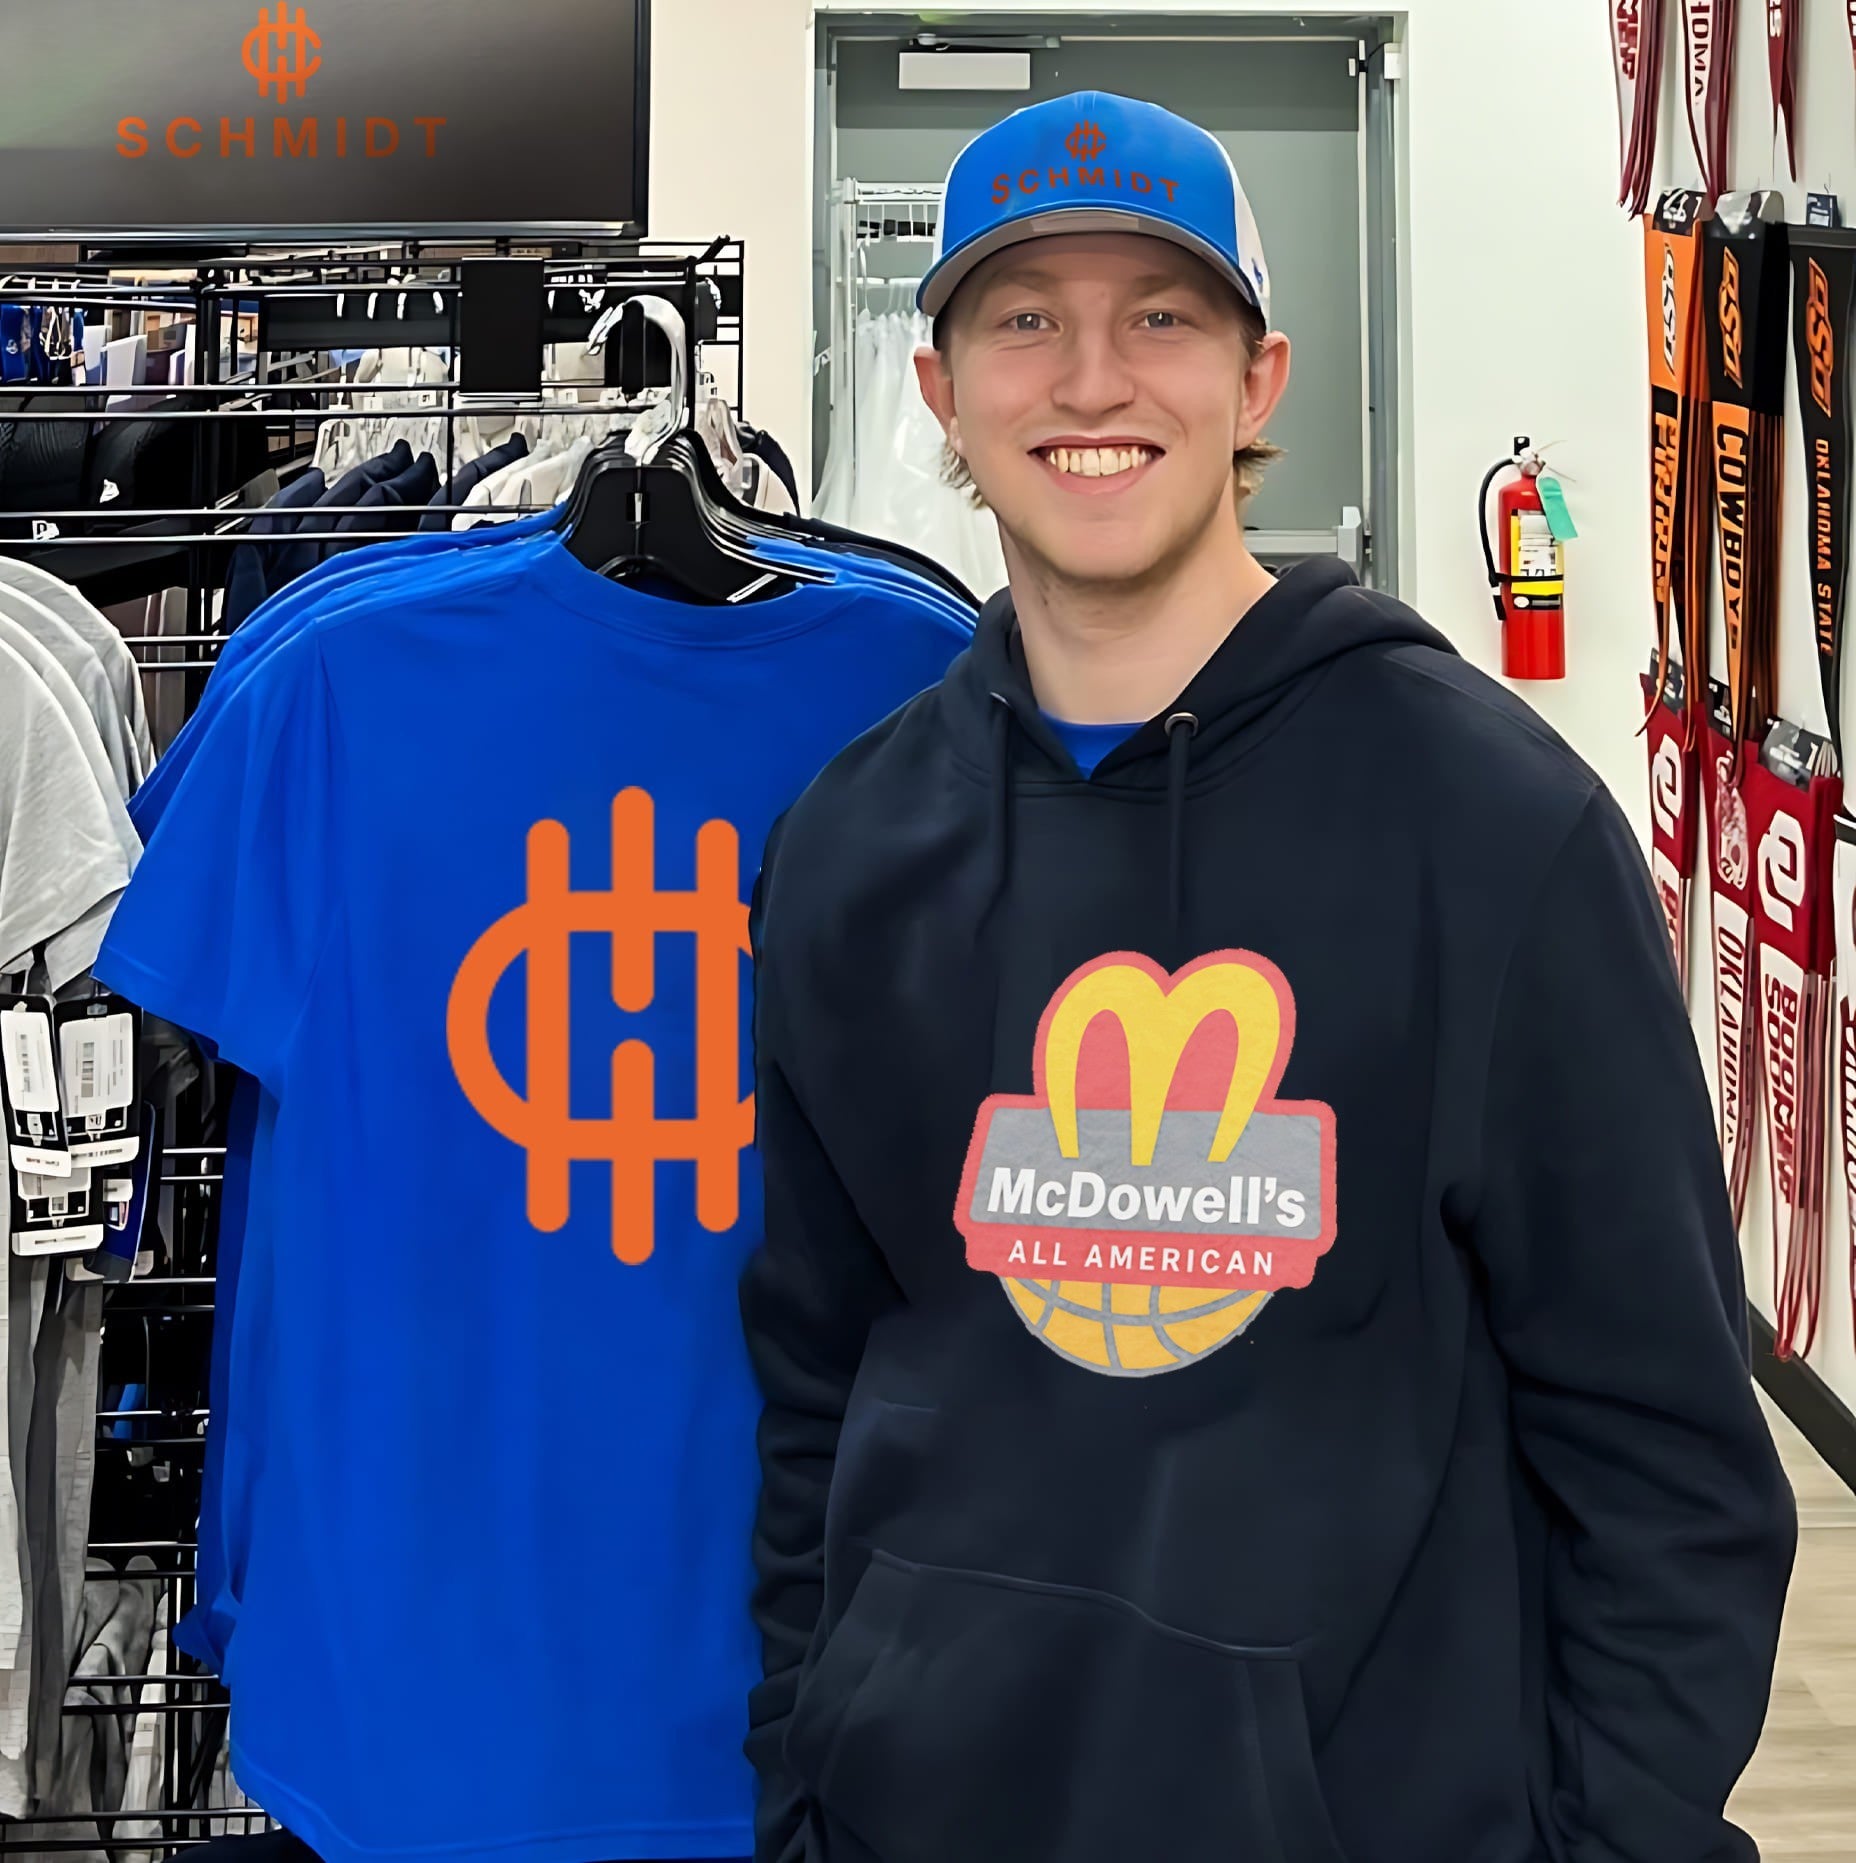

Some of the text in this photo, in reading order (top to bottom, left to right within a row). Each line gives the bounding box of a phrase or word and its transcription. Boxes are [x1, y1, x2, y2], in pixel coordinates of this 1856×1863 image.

[116, 117, 447, 159] SCHMIDT
[991, 167, 1179, 205] SCHMIDT
[1815, 438, 1832, 570] OKLAHOMA
[987, 1166, 1306, 1228] McDowell's
[1008, 1240, 1274, 1277] ALL AMERICAN
